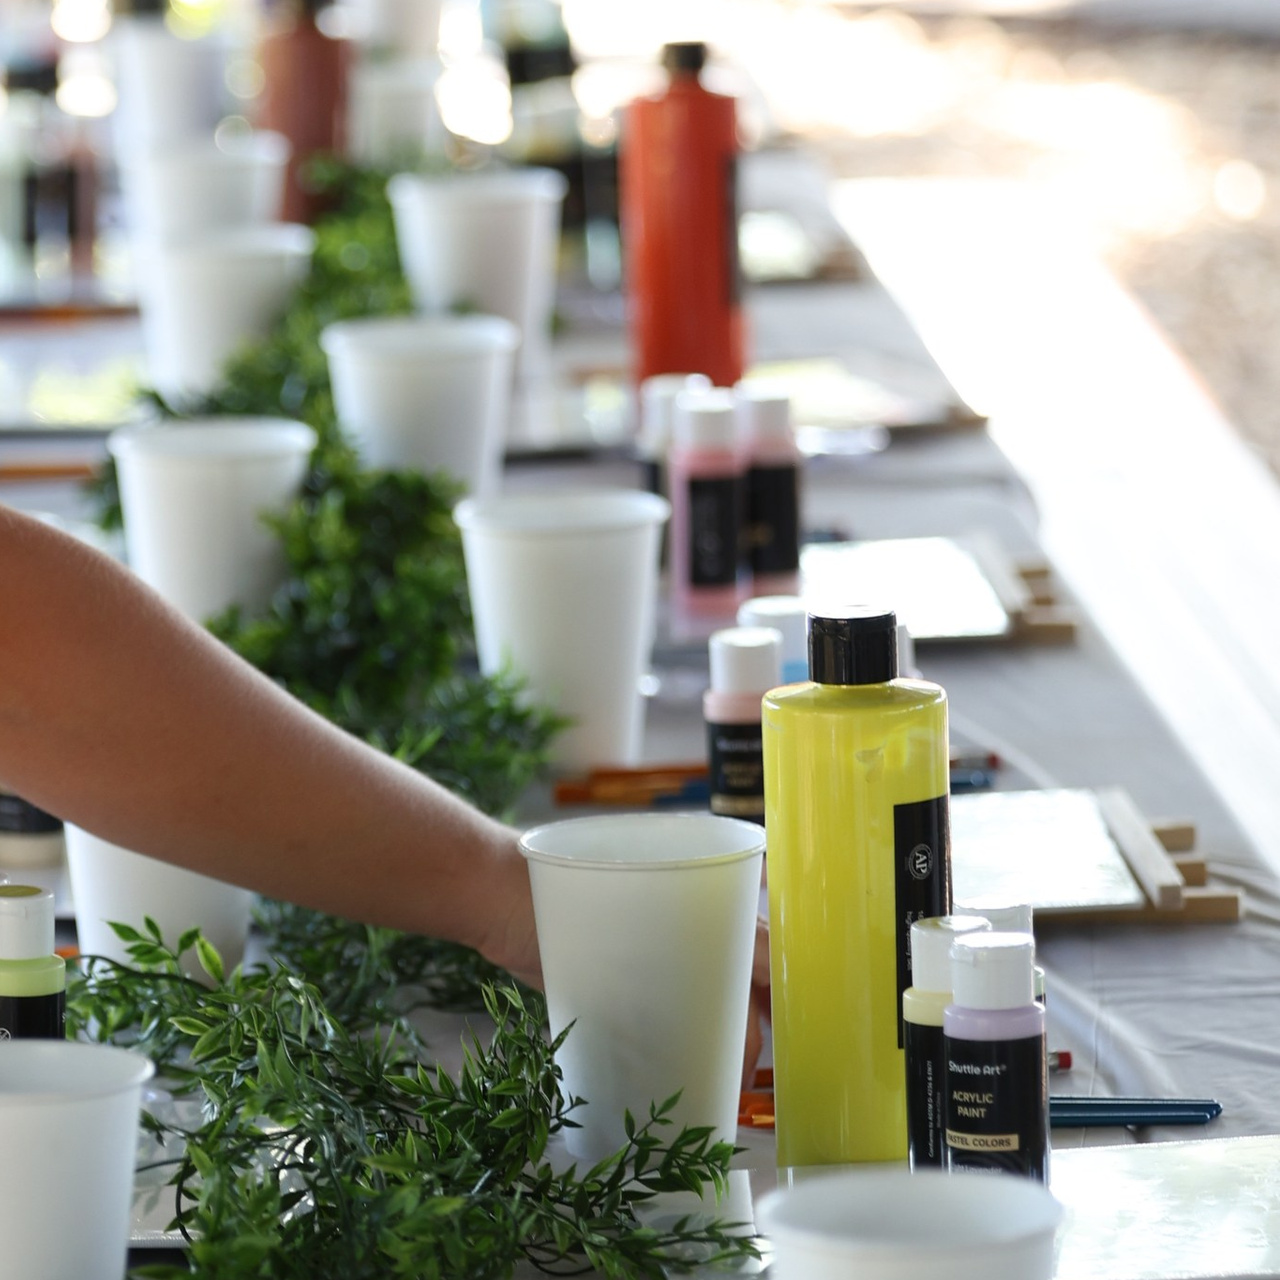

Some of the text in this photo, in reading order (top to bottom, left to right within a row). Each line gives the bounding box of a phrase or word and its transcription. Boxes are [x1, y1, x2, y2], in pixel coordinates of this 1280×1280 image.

[949, 1060, 981, 1076] Shuttle
[952, 1091, 994, 1104] ACRYLIC
[957, 1106, 986, 1118] PAINT
[972, 1138, 1011, 1148] COLORS
